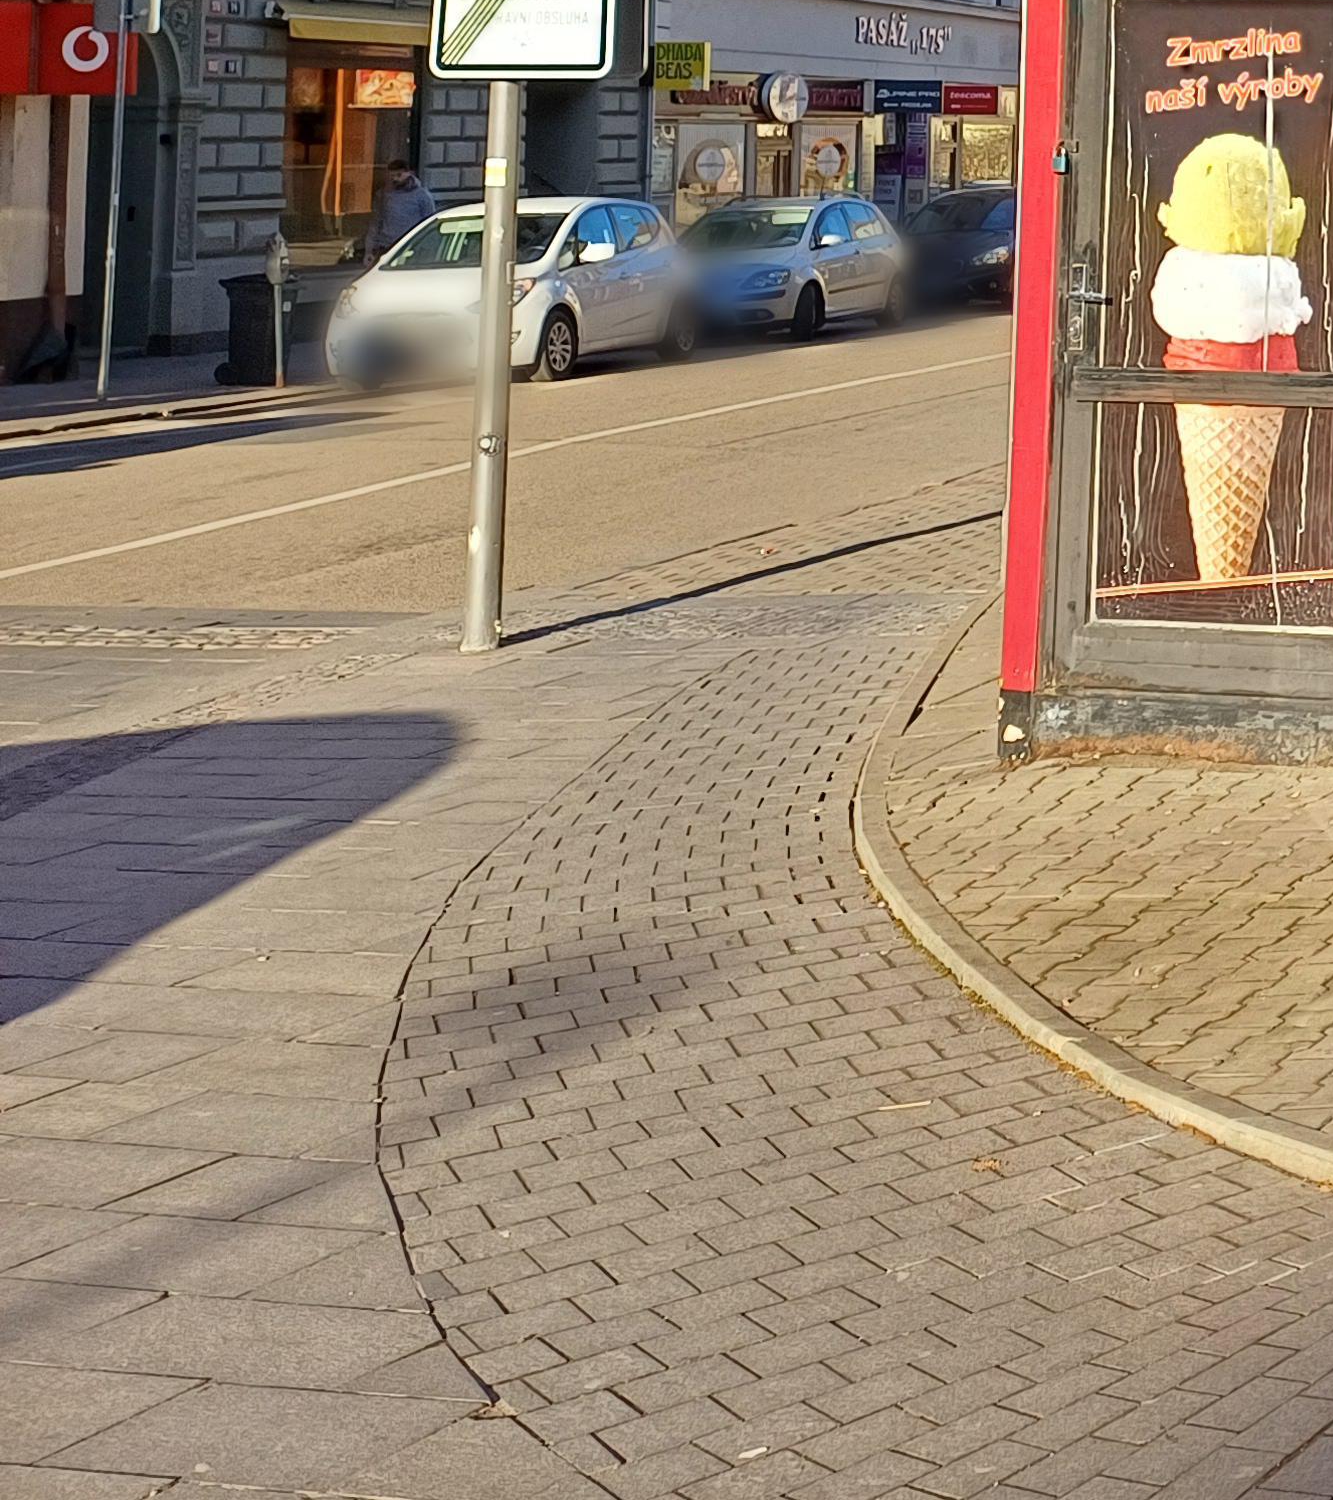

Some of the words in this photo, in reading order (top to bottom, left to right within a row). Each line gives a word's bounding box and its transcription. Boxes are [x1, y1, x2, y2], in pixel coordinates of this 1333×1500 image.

[855, 12, 910, 48] PASÁŽ
[1166, 28, 1302, 67] Zmrzlina
[1145, 75, 1209, 114] naší
[1217, 67, 1324, 112] výroby
